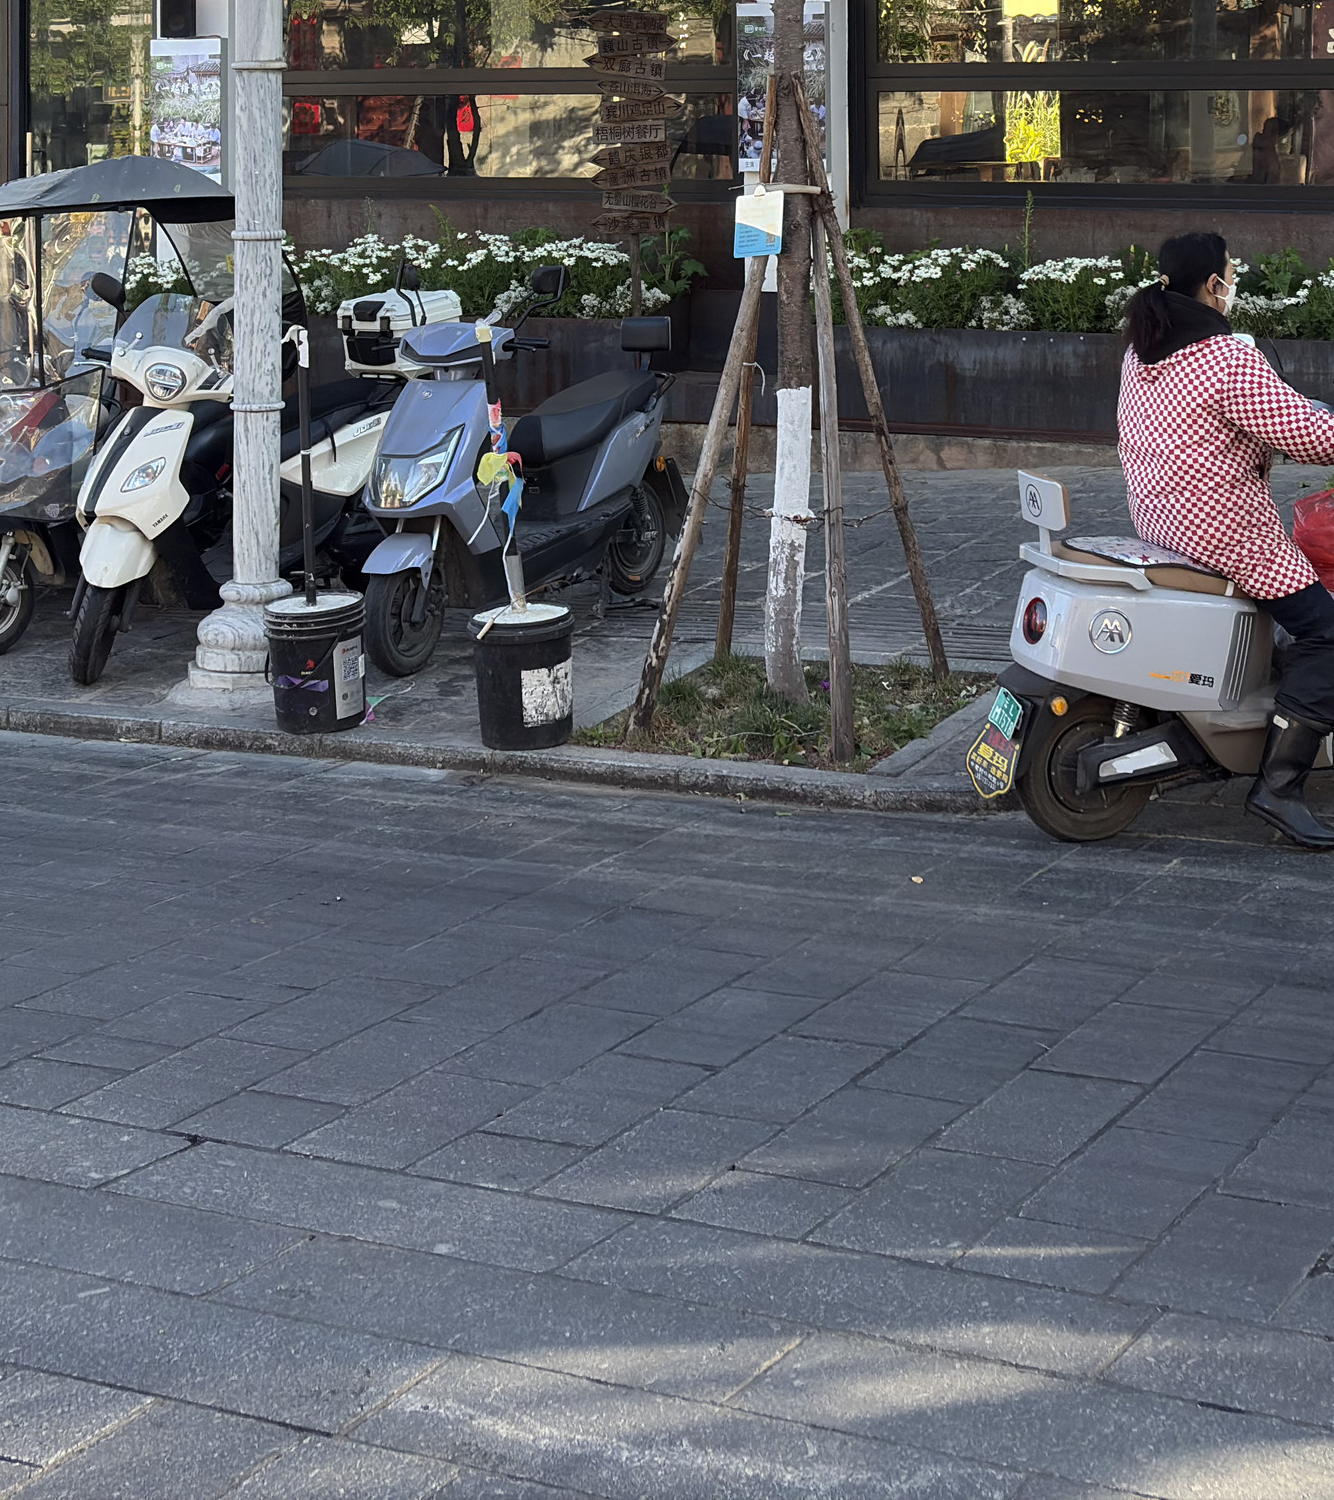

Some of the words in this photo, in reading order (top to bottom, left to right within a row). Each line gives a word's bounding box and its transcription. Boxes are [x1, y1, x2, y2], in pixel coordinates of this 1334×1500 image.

[604, 14, 664, 31] 大理古城
[602, 36, 659, 53] 巍山古镇
[602, 57, 664, 78] 双廊古镇
[609, 81, 652, 95] 苍山洱海
[605, 101, 666, 120] 宾川鸡足山
[595, 124, 663, 141] 梧桐树餐厅
[608, 143, 668, 166] 鹤庆银都
[604, 191, 659, 209] 无量山樱花谷
